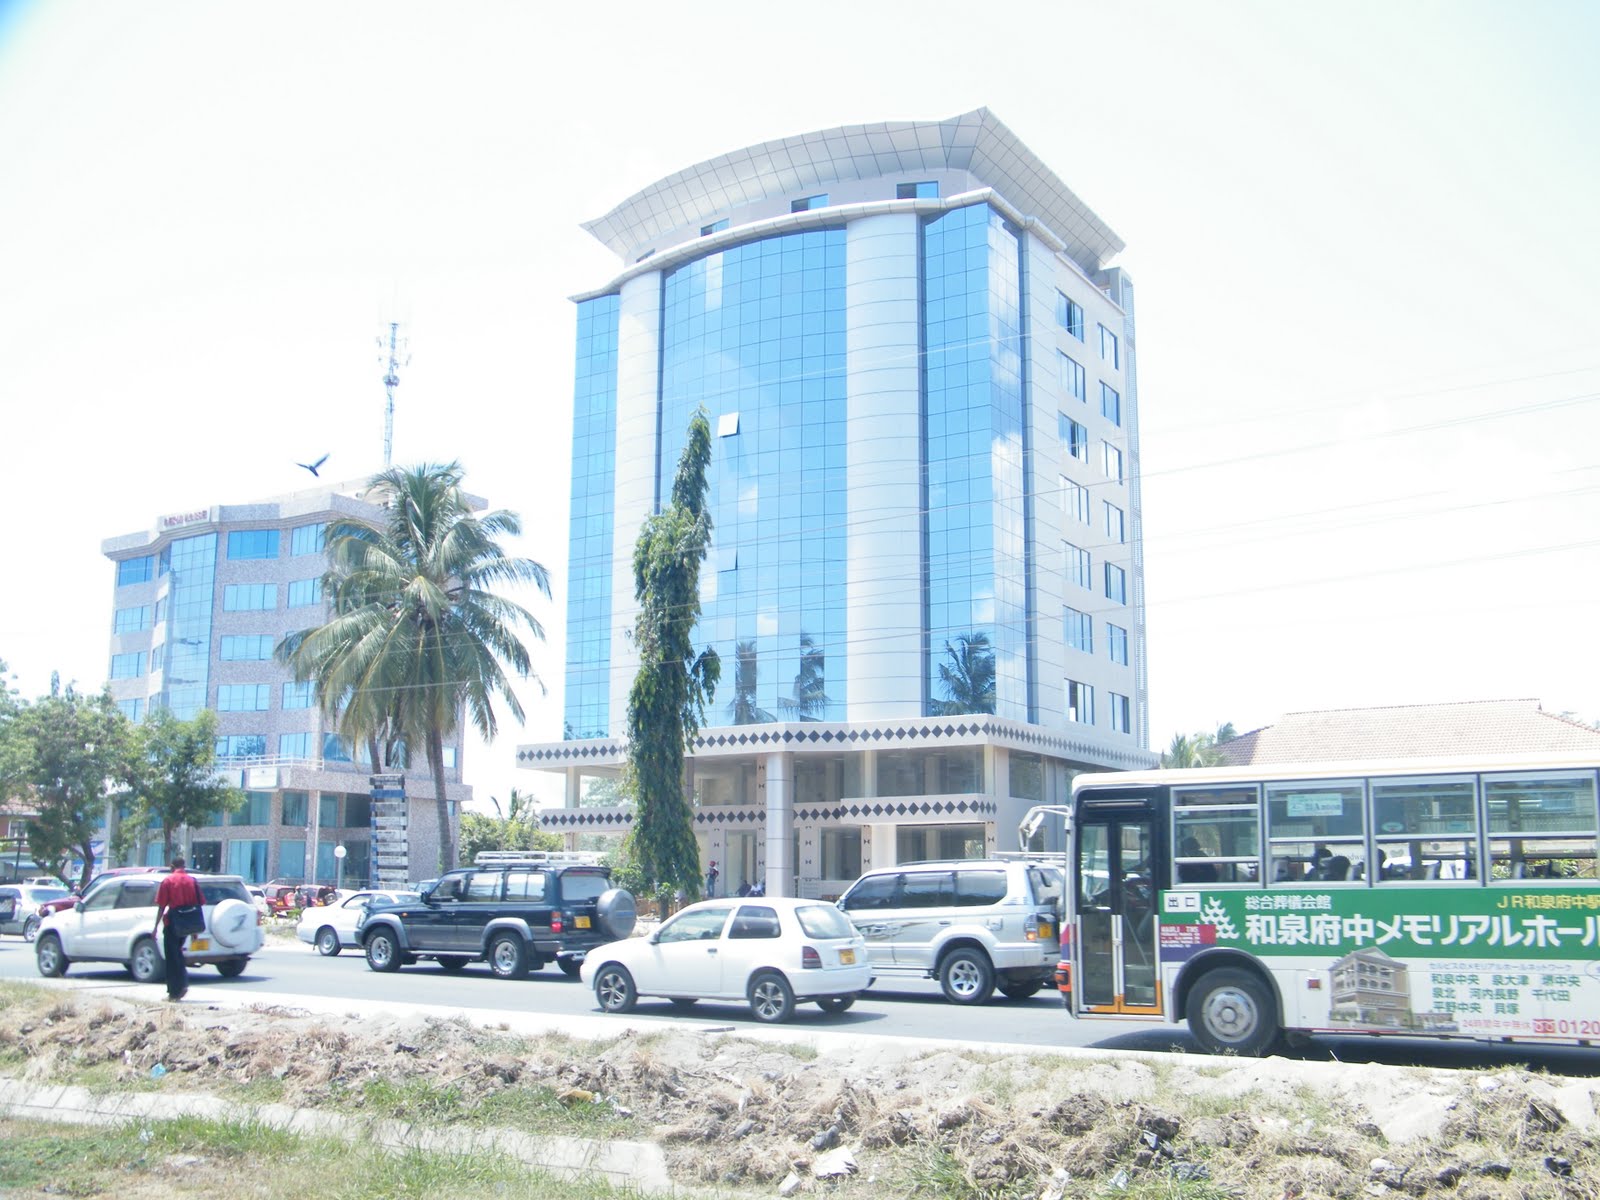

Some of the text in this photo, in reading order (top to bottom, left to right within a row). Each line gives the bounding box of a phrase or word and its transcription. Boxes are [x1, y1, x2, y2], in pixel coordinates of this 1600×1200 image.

[1168, 896, 1196, 908] 出口
[1431, 973, 1480, 985] 和泉中央
[1492, 974, 1530, 986] 泉大津
[1432, 987, 1571, 1002] 泉北 河内長野 千代田
[1433, 1001, 1520, 1015] 平野中央 貝塚
